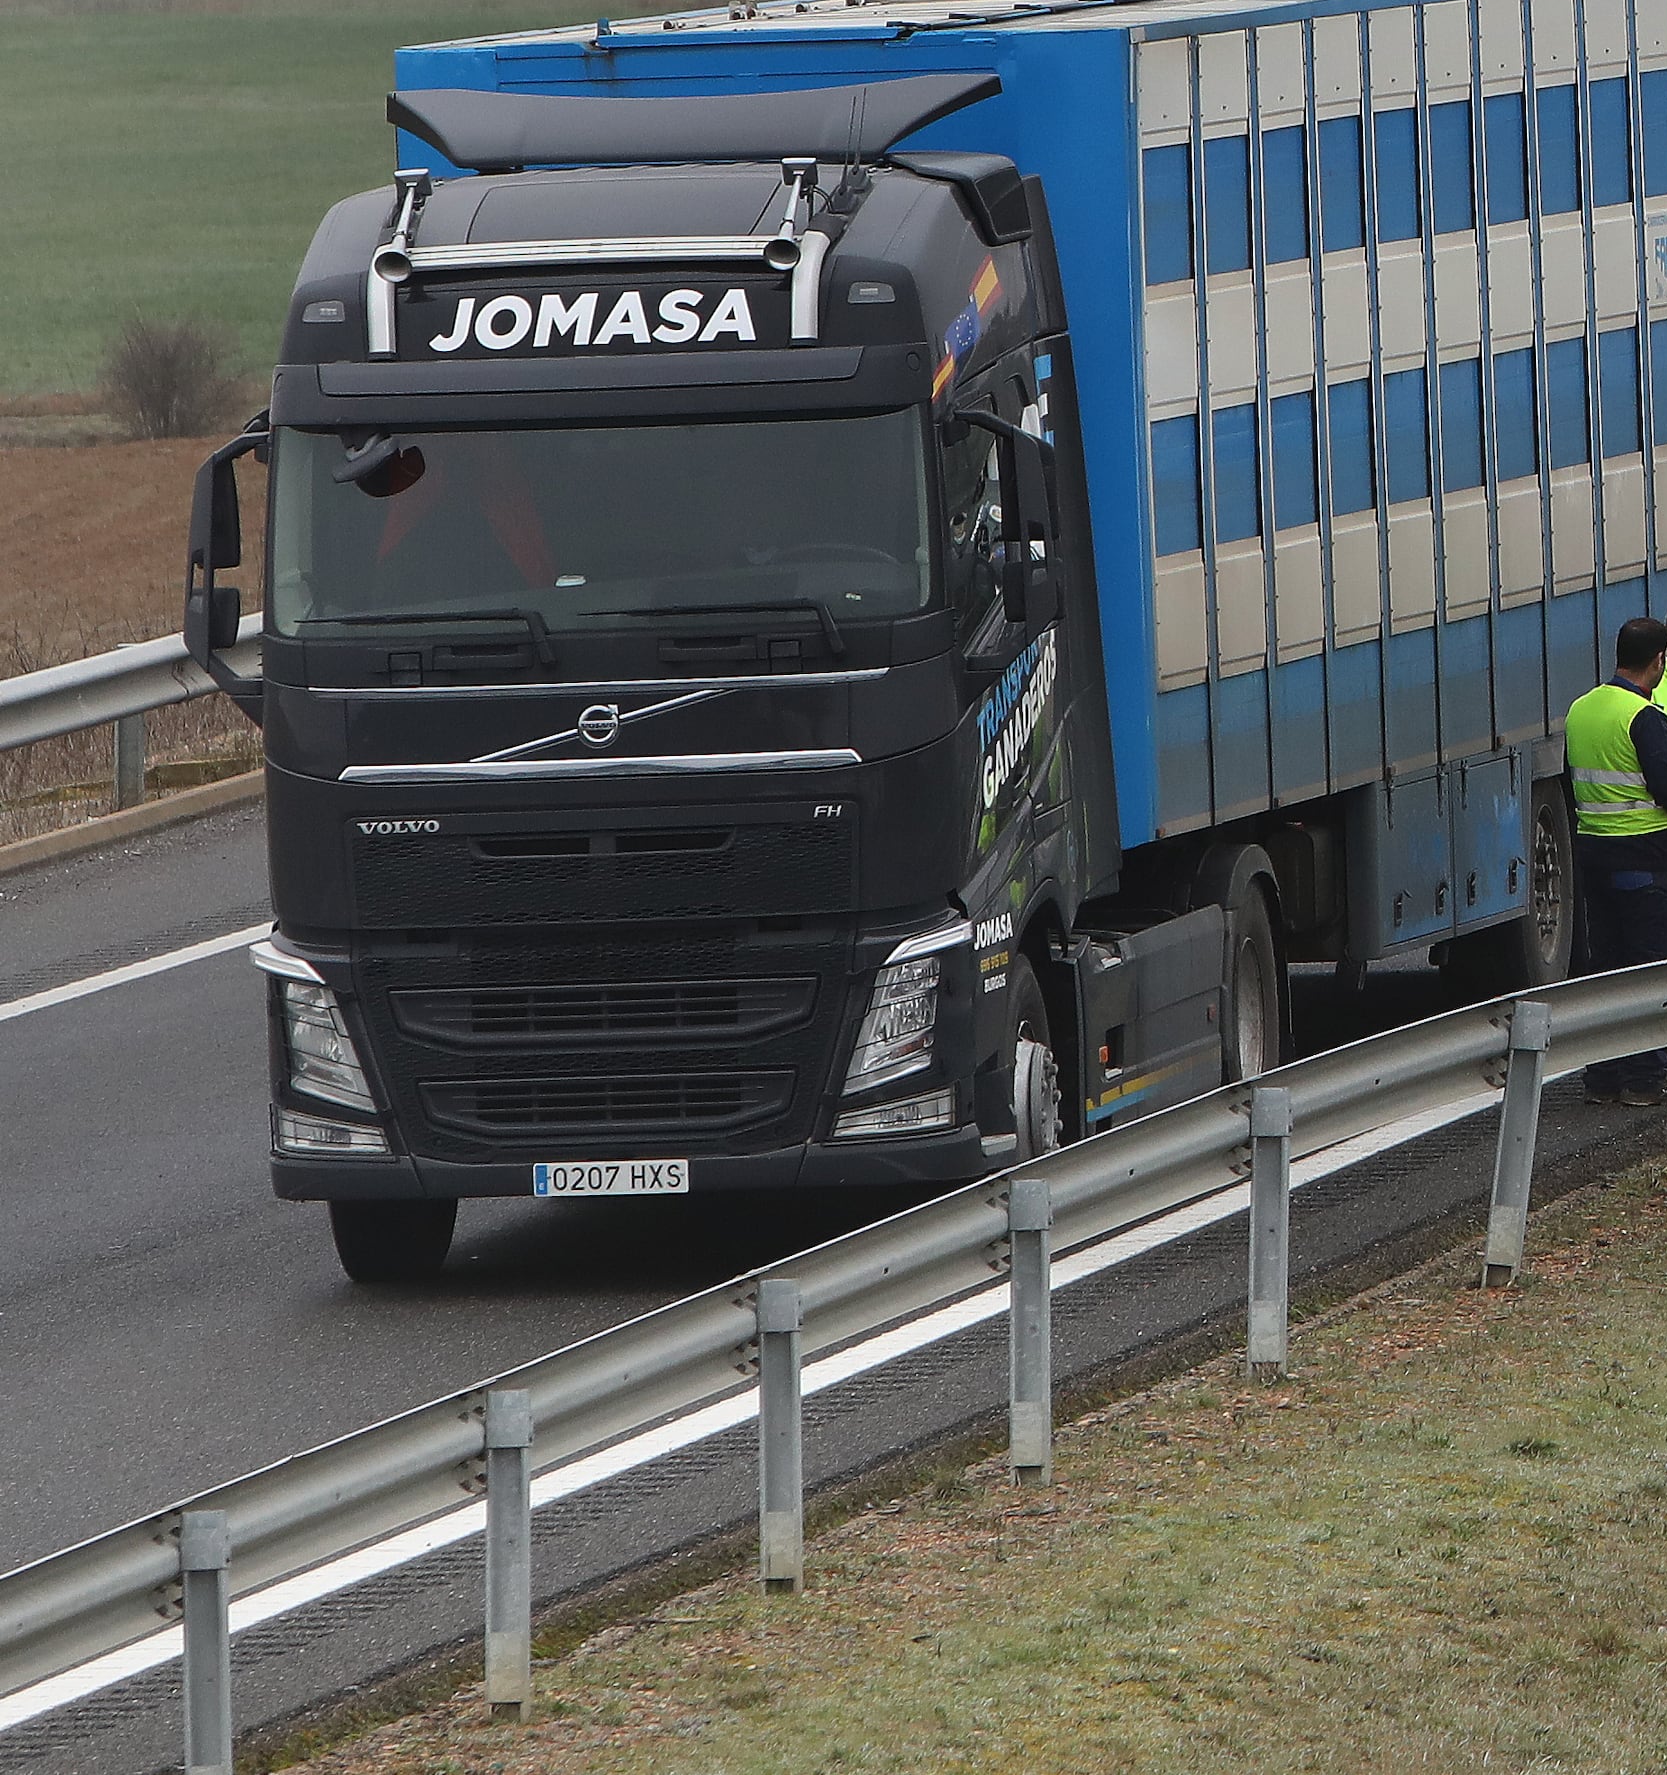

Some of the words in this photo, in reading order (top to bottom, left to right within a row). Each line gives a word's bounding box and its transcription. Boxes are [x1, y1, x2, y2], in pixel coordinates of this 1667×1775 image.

[429, 288, 756, 352] JOMASA
[982, 629, 1057, 810] GANADEROS
[356, 820, 440, 835] VOLVO
[813, 805, 842, 818] FH
[973, 912, 1014, 951] JOMASA
[553, 1166, 620, 1192] 0207
[630, 1164, 681, 1188] HXS
